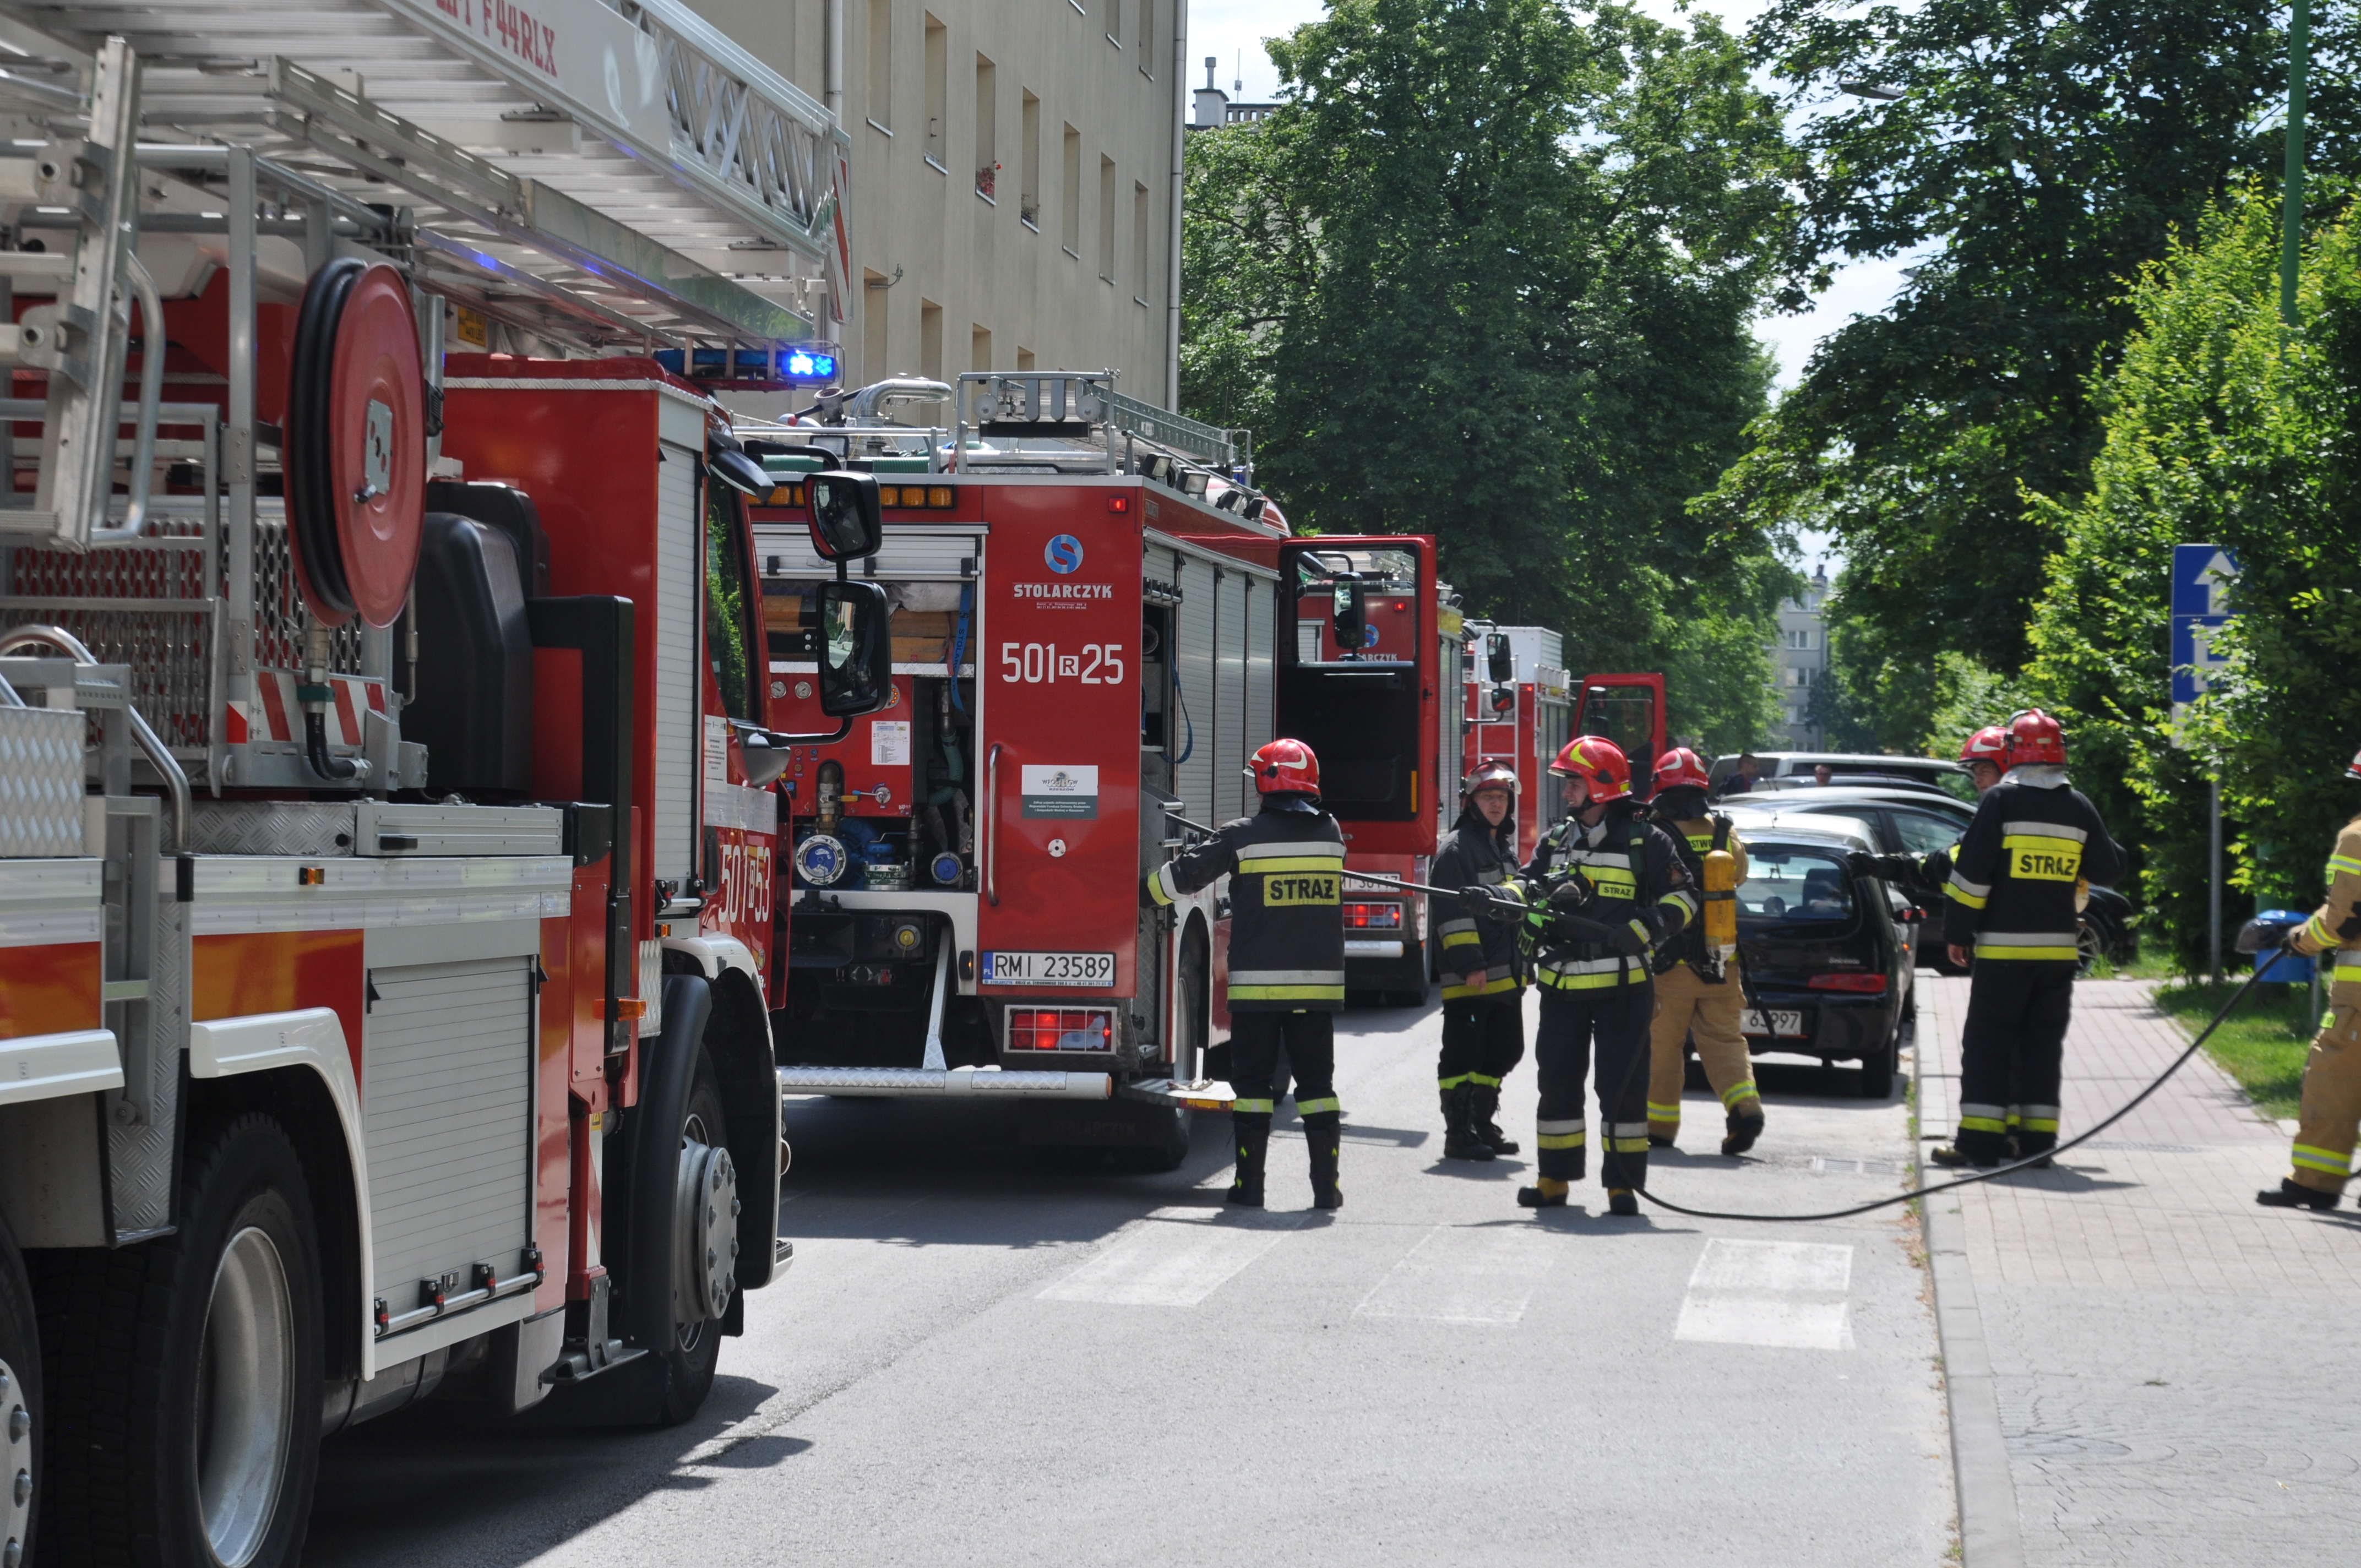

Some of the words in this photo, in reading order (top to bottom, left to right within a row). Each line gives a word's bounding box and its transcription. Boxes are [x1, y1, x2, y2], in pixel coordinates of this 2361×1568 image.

[1013, 584, 1112, 598] STOLARCZYK
[1002, 642, 1055, 683] 501
[1062, 657, 1076, 674] R
[1081, 643, 1124, 685] 25
[719, 844, 748, 923] 501
[755, 846, 770, 922] 53
[994, 955, 1031, 978] RMI
[1044, 956, 1111, 978] 23589
